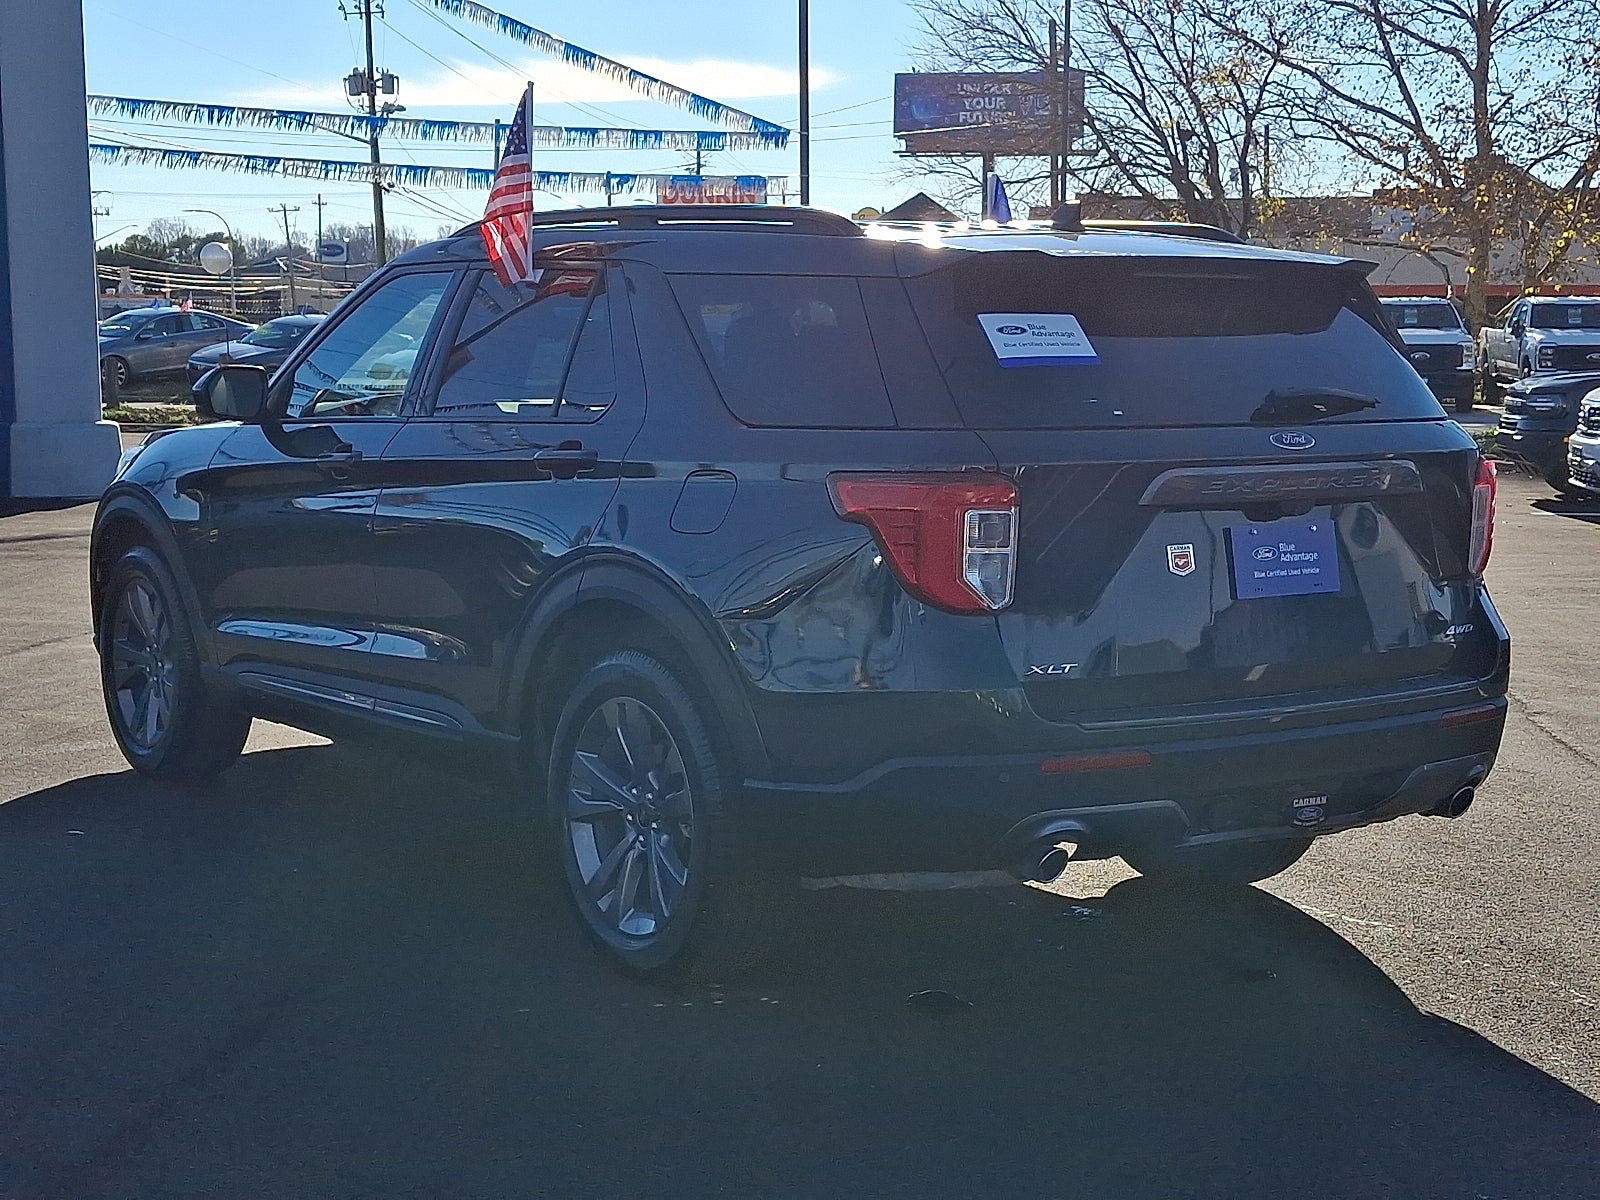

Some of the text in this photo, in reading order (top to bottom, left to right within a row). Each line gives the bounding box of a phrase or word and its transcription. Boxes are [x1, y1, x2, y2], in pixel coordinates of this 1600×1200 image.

[963, 97, 1007, 110] YOUR
[1027, 323, 1047, 331] Blue
[1032, 330, 1076, 339] Advantage
[1201, 471, 1392, 494] EXPLORER
[1279, 542, 1296, 552] Blue
[1280, 551, 1319, 562] Advantage
[1266, 569, 1288, 578] Certified
[1288, 568, 1301, 576] Used
[1302, 567, 1320, 575] Vehicle
[1445, 623, 1474, 635] 4WD
[1024, 663, 1079, 676] XLT
[1293, 795, 1328, 808] CARMAN
